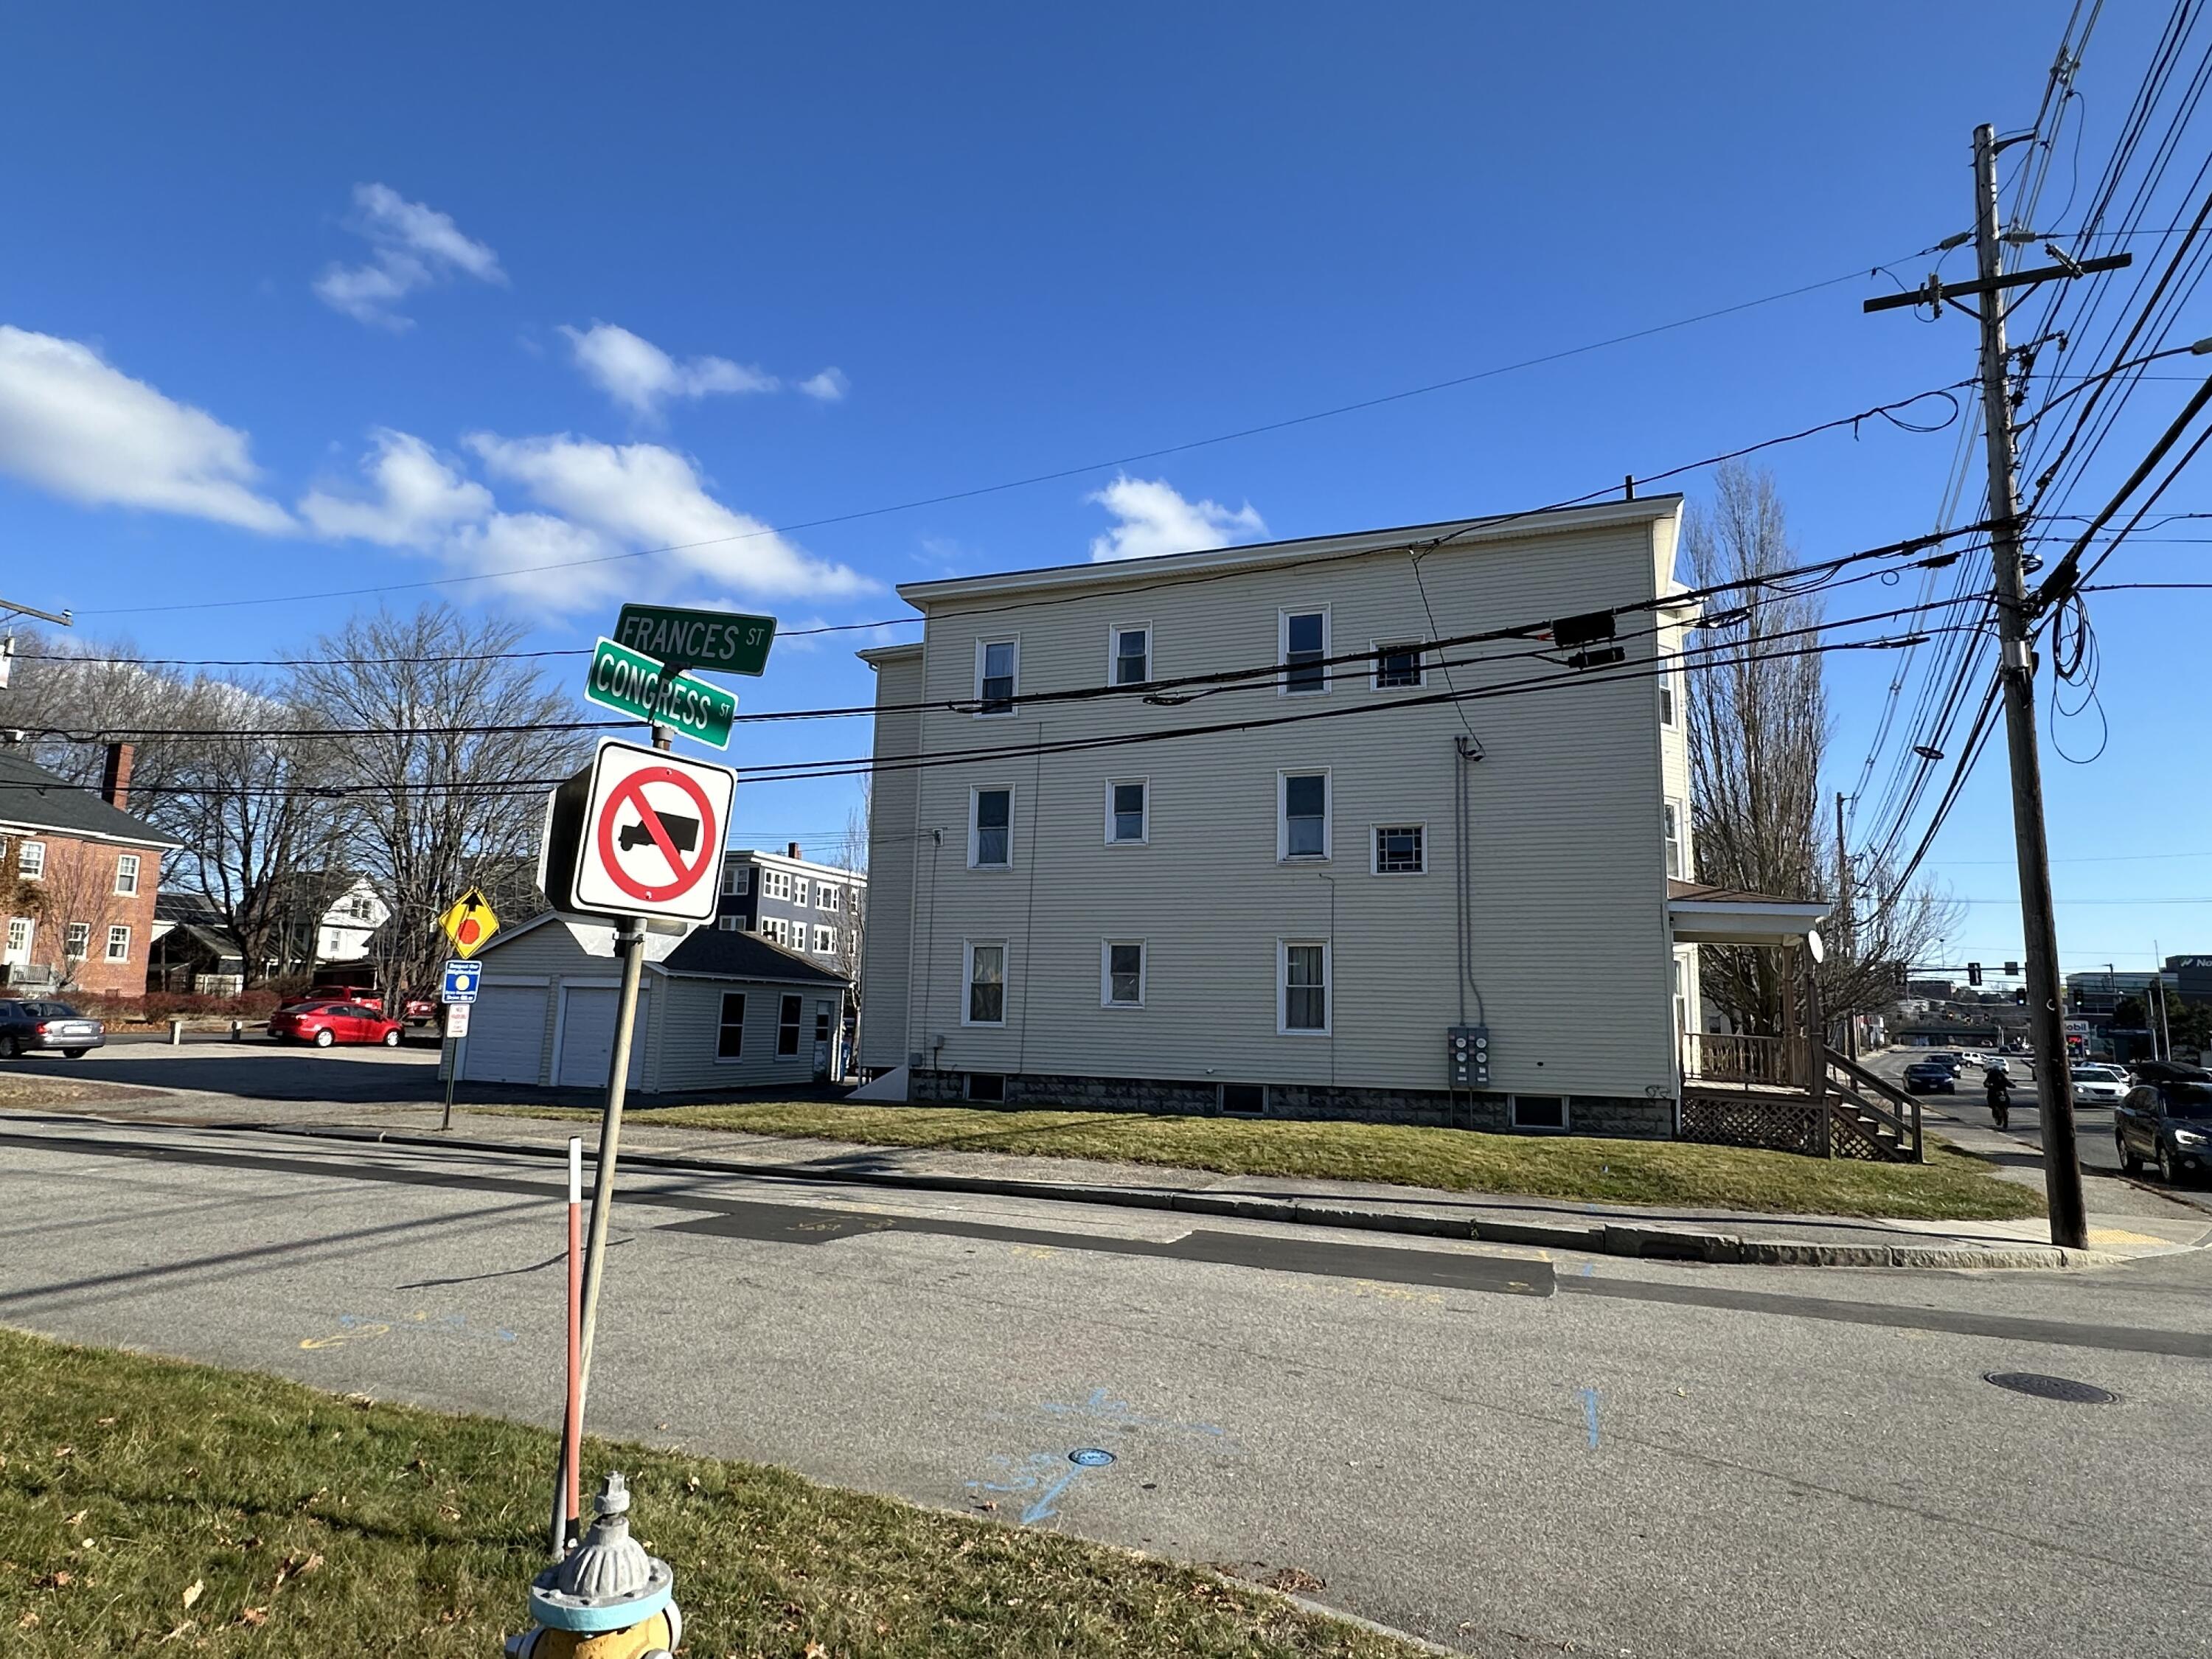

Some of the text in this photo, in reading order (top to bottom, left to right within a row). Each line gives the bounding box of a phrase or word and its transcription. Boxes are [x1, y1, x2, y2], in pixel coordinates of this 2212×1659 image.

[621, 616, 765, 661] FRANCES ST
[596, 653, 731, 730] CONGRESS ST
